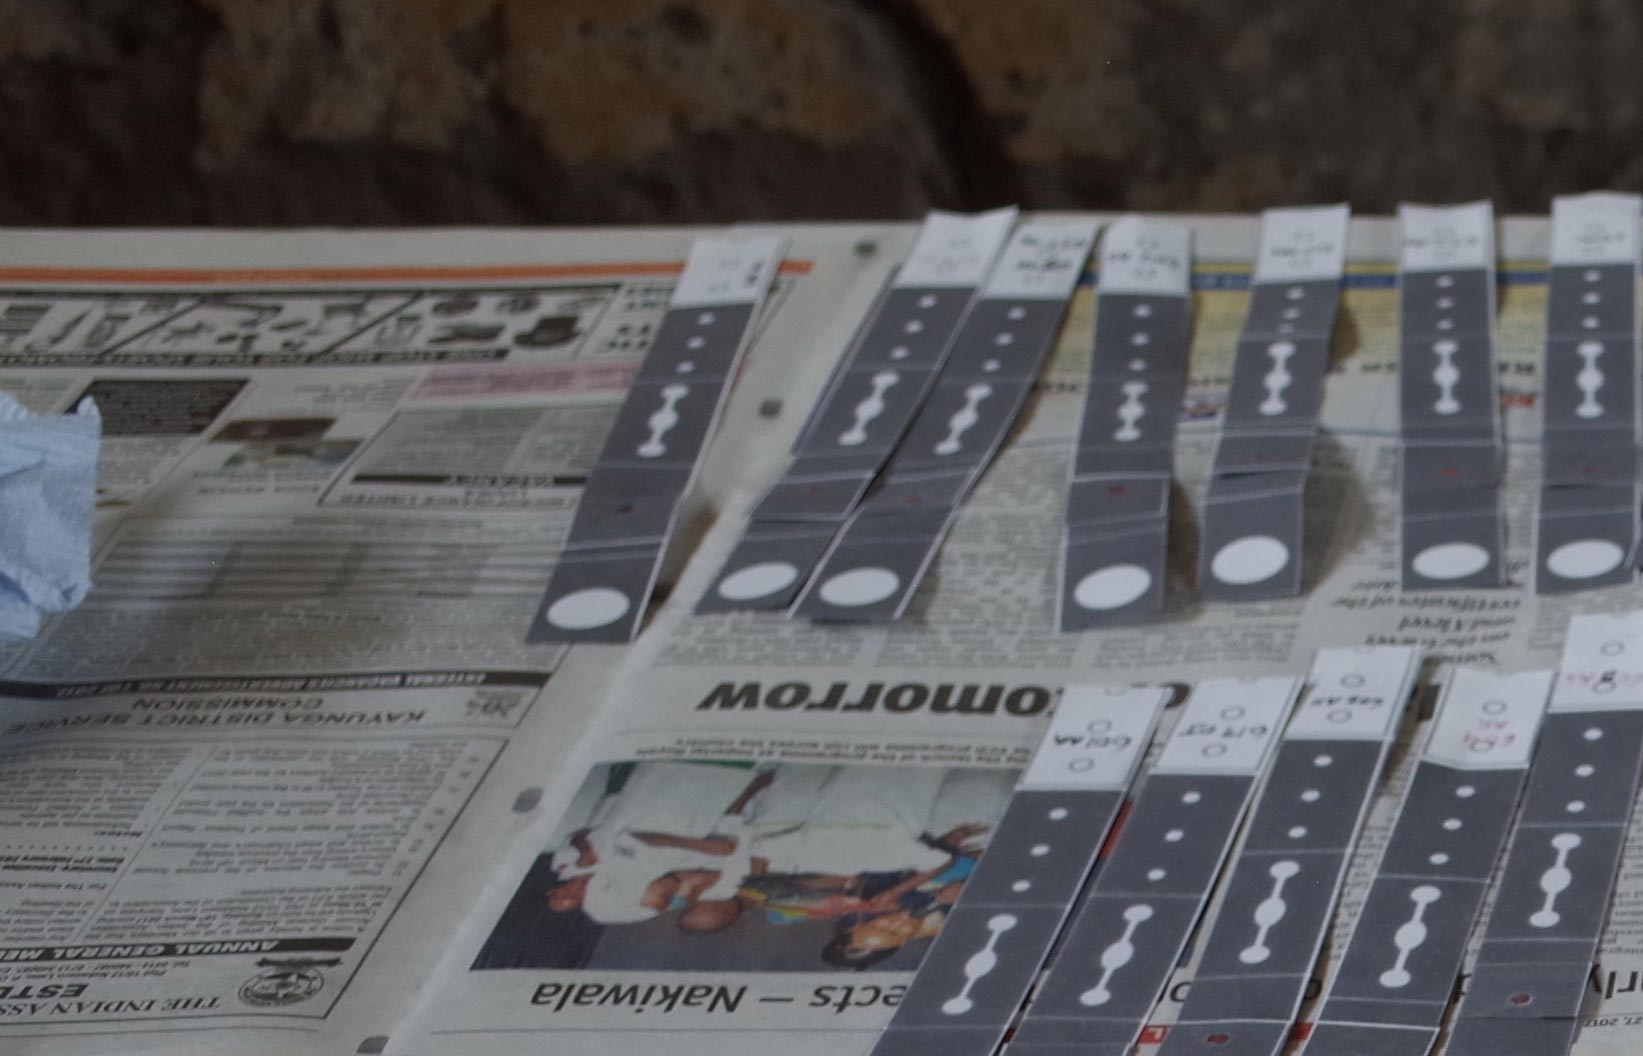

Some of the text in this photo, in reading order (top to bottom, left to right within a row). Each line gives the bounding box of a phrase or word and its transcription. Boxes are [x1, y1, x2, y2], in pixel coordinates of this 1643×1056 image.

[131, 697, 323, 711] COMMISSION
[697, 682, 1051, 718] omorrow
[5, 710, 425, 734] KAYUNGA DISTRICT SERVICE
[530, 982, 747, 1013] Nakiwala
